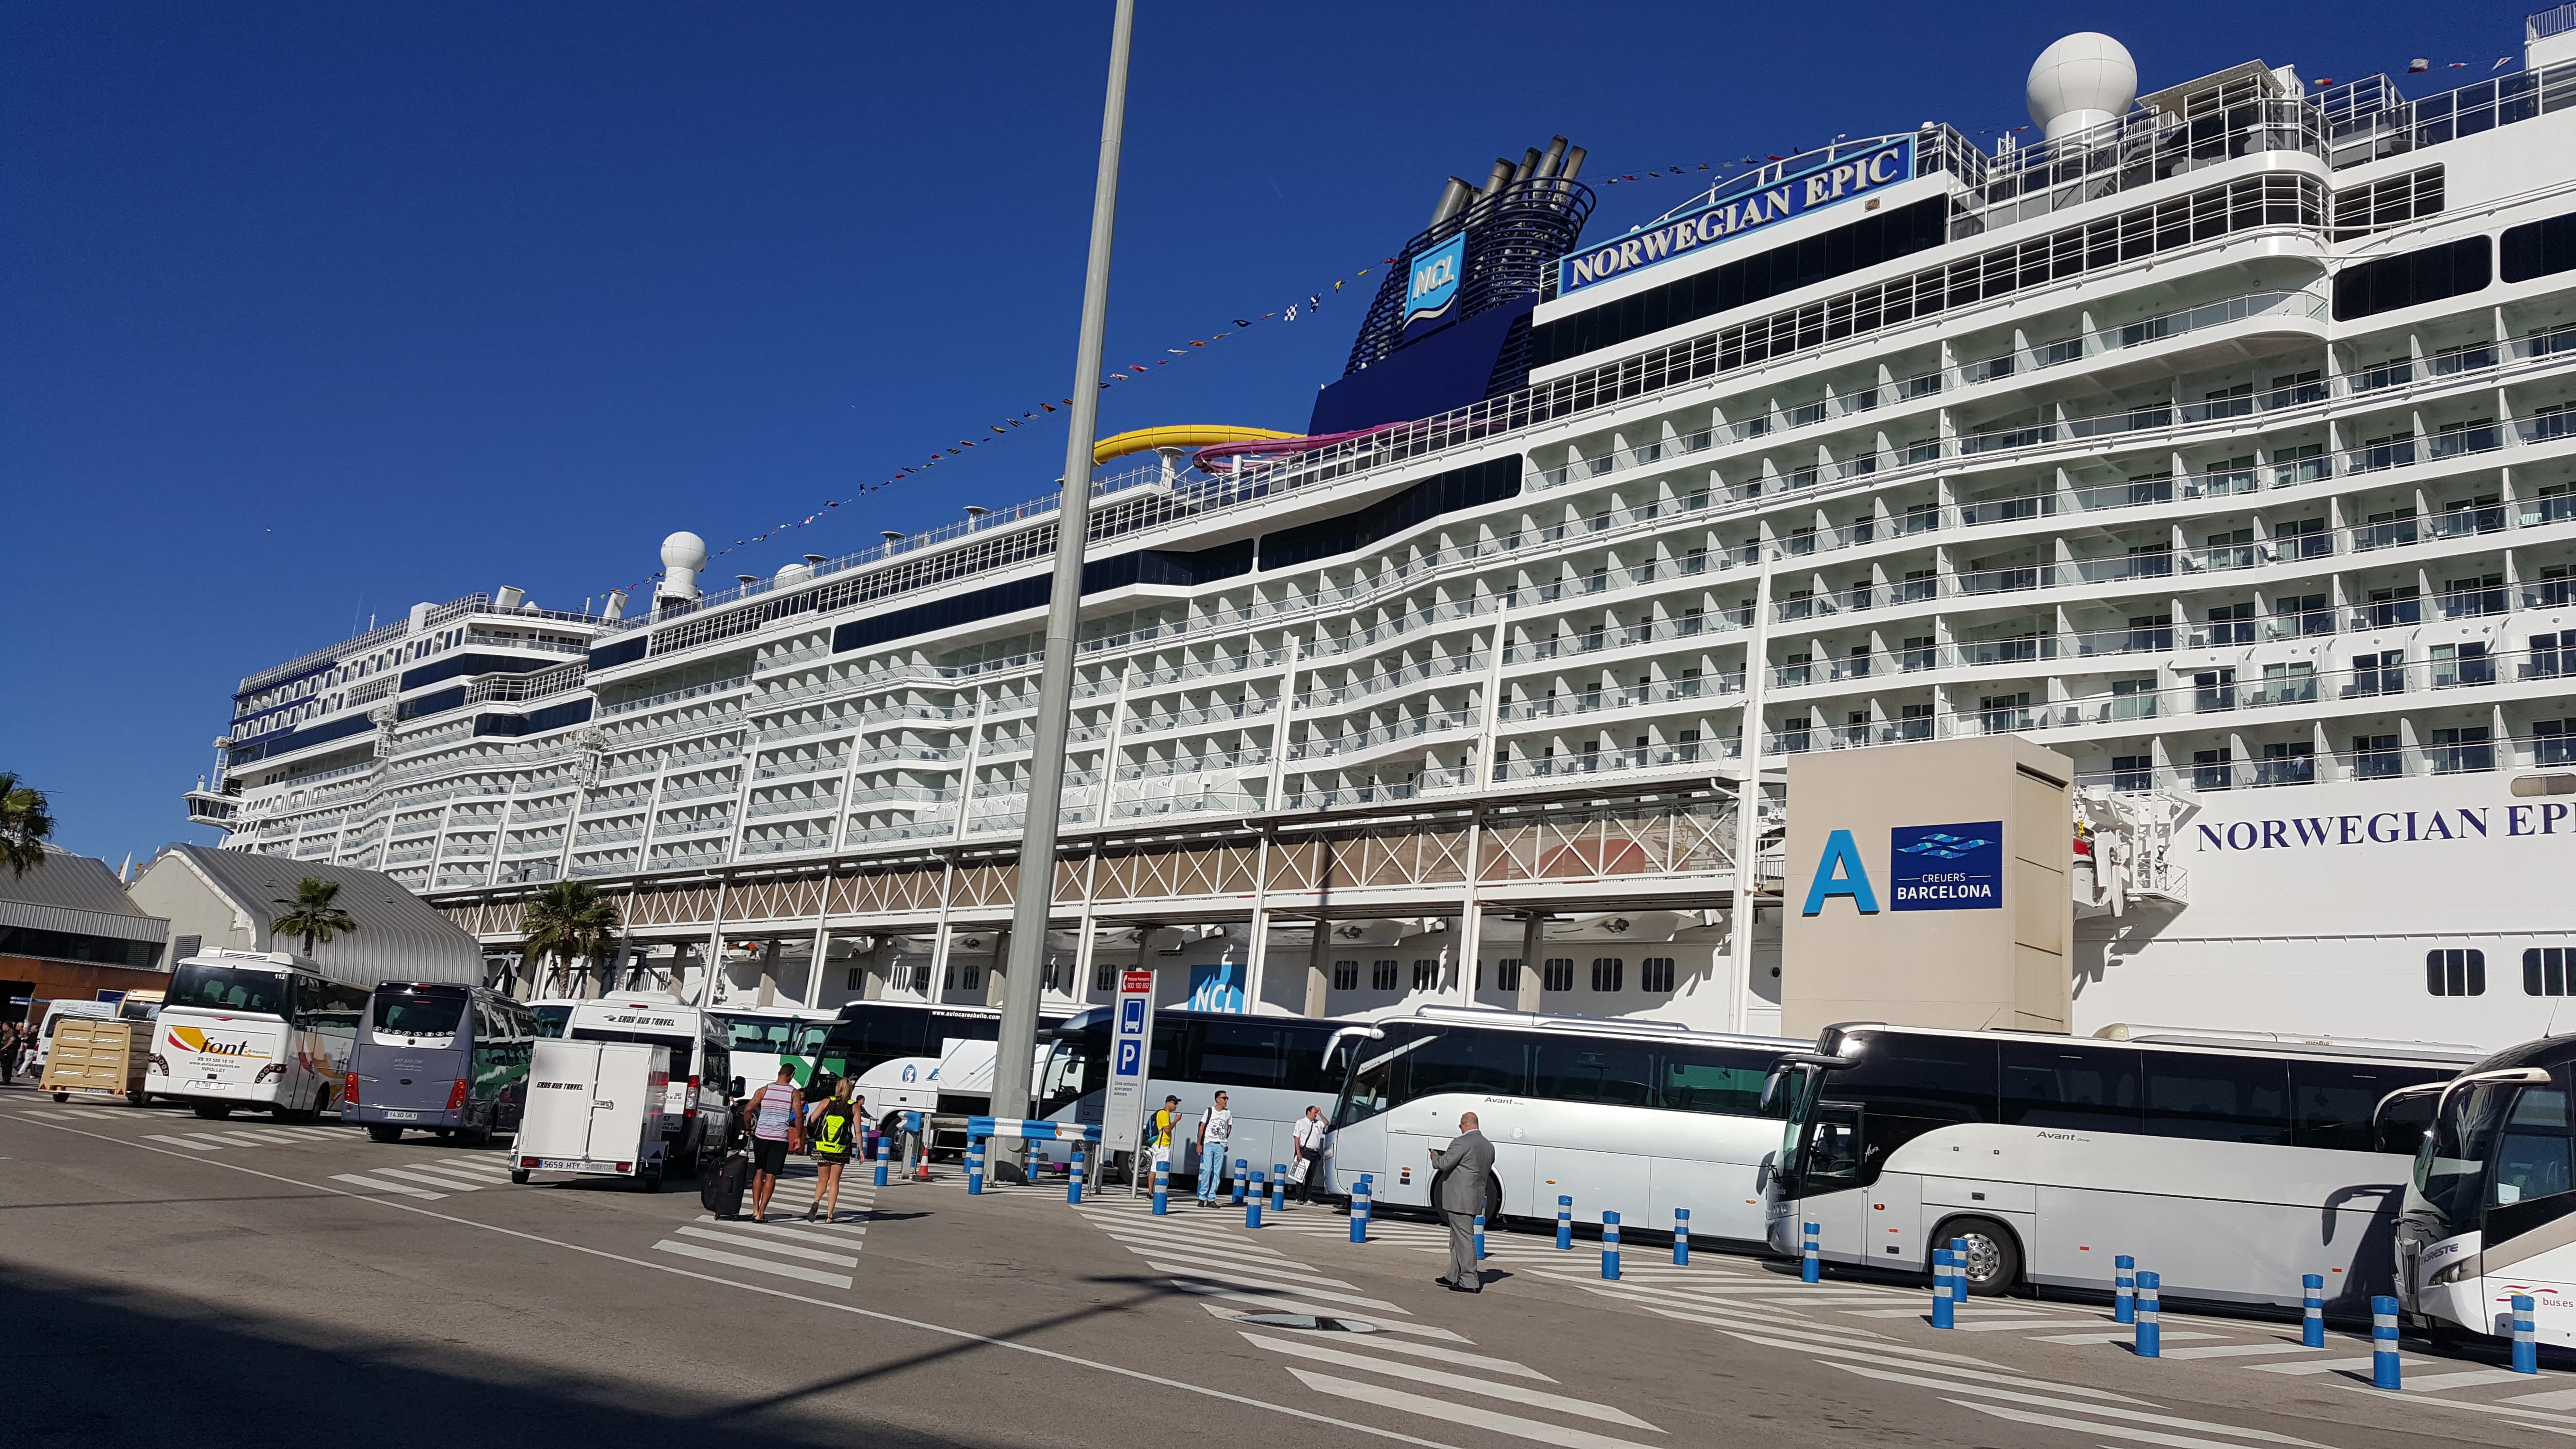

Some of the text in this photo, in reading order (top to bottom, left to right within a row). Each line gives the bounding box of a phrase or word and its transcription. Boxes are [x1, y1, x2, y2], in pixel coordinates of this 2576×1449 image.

[1570, 148, 1898, 288] NORWEGIAN EPIC
[1413, 255, 1454, 301] NCL
[2196, 802, 2576, 852] NORWEGIAN EP
[1803, 829, 1880, 917] A
[1922, 873, 1965, 883] CREUERS
[1898, 884, 1992, 900] BARCELONA
[1194, 983, 1236, 1014] NCL
[651, 1018, 675, 1026] TRAVEL
[932, 1011, 1000, 1020] www.autocaresbello.com
[199, 1037, 248, 1056] font
[1122, 1044, 1135, 1070] P
[2037, 1131, 2075, 1141] Avant
[1865, 1143, 1880, 1162] Aura
[2543, 1297, 2574, 1307] bus.es
